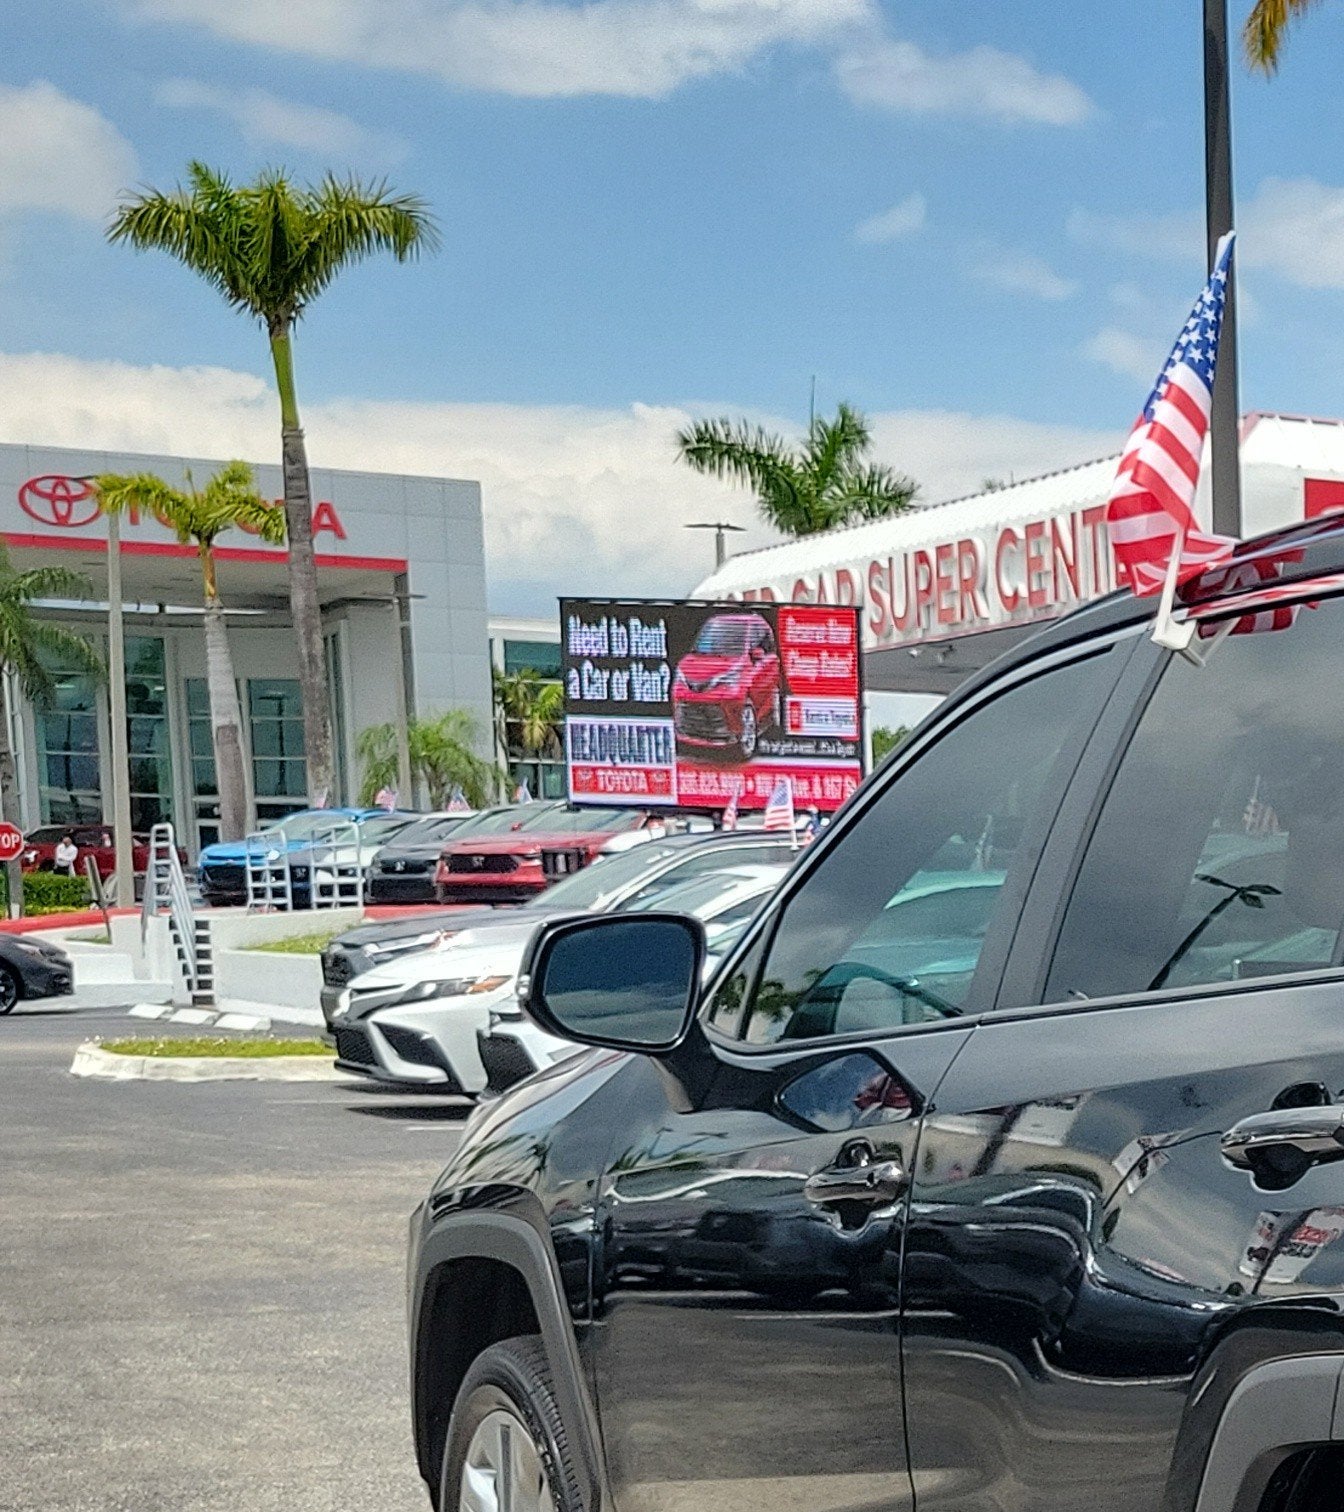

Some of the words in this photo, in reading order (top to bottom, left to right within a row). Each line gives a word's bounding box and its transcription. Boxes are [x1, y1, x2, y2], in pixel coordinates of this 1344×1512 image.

[868, 539, 989, 637] SUPER
[995, 505, 1133, 613] CENT
[582, 659, 610, 700] Car
[571, 723, 675, 766] HEADQUARTER
[596, 769, 649, 793] TOYOTA
